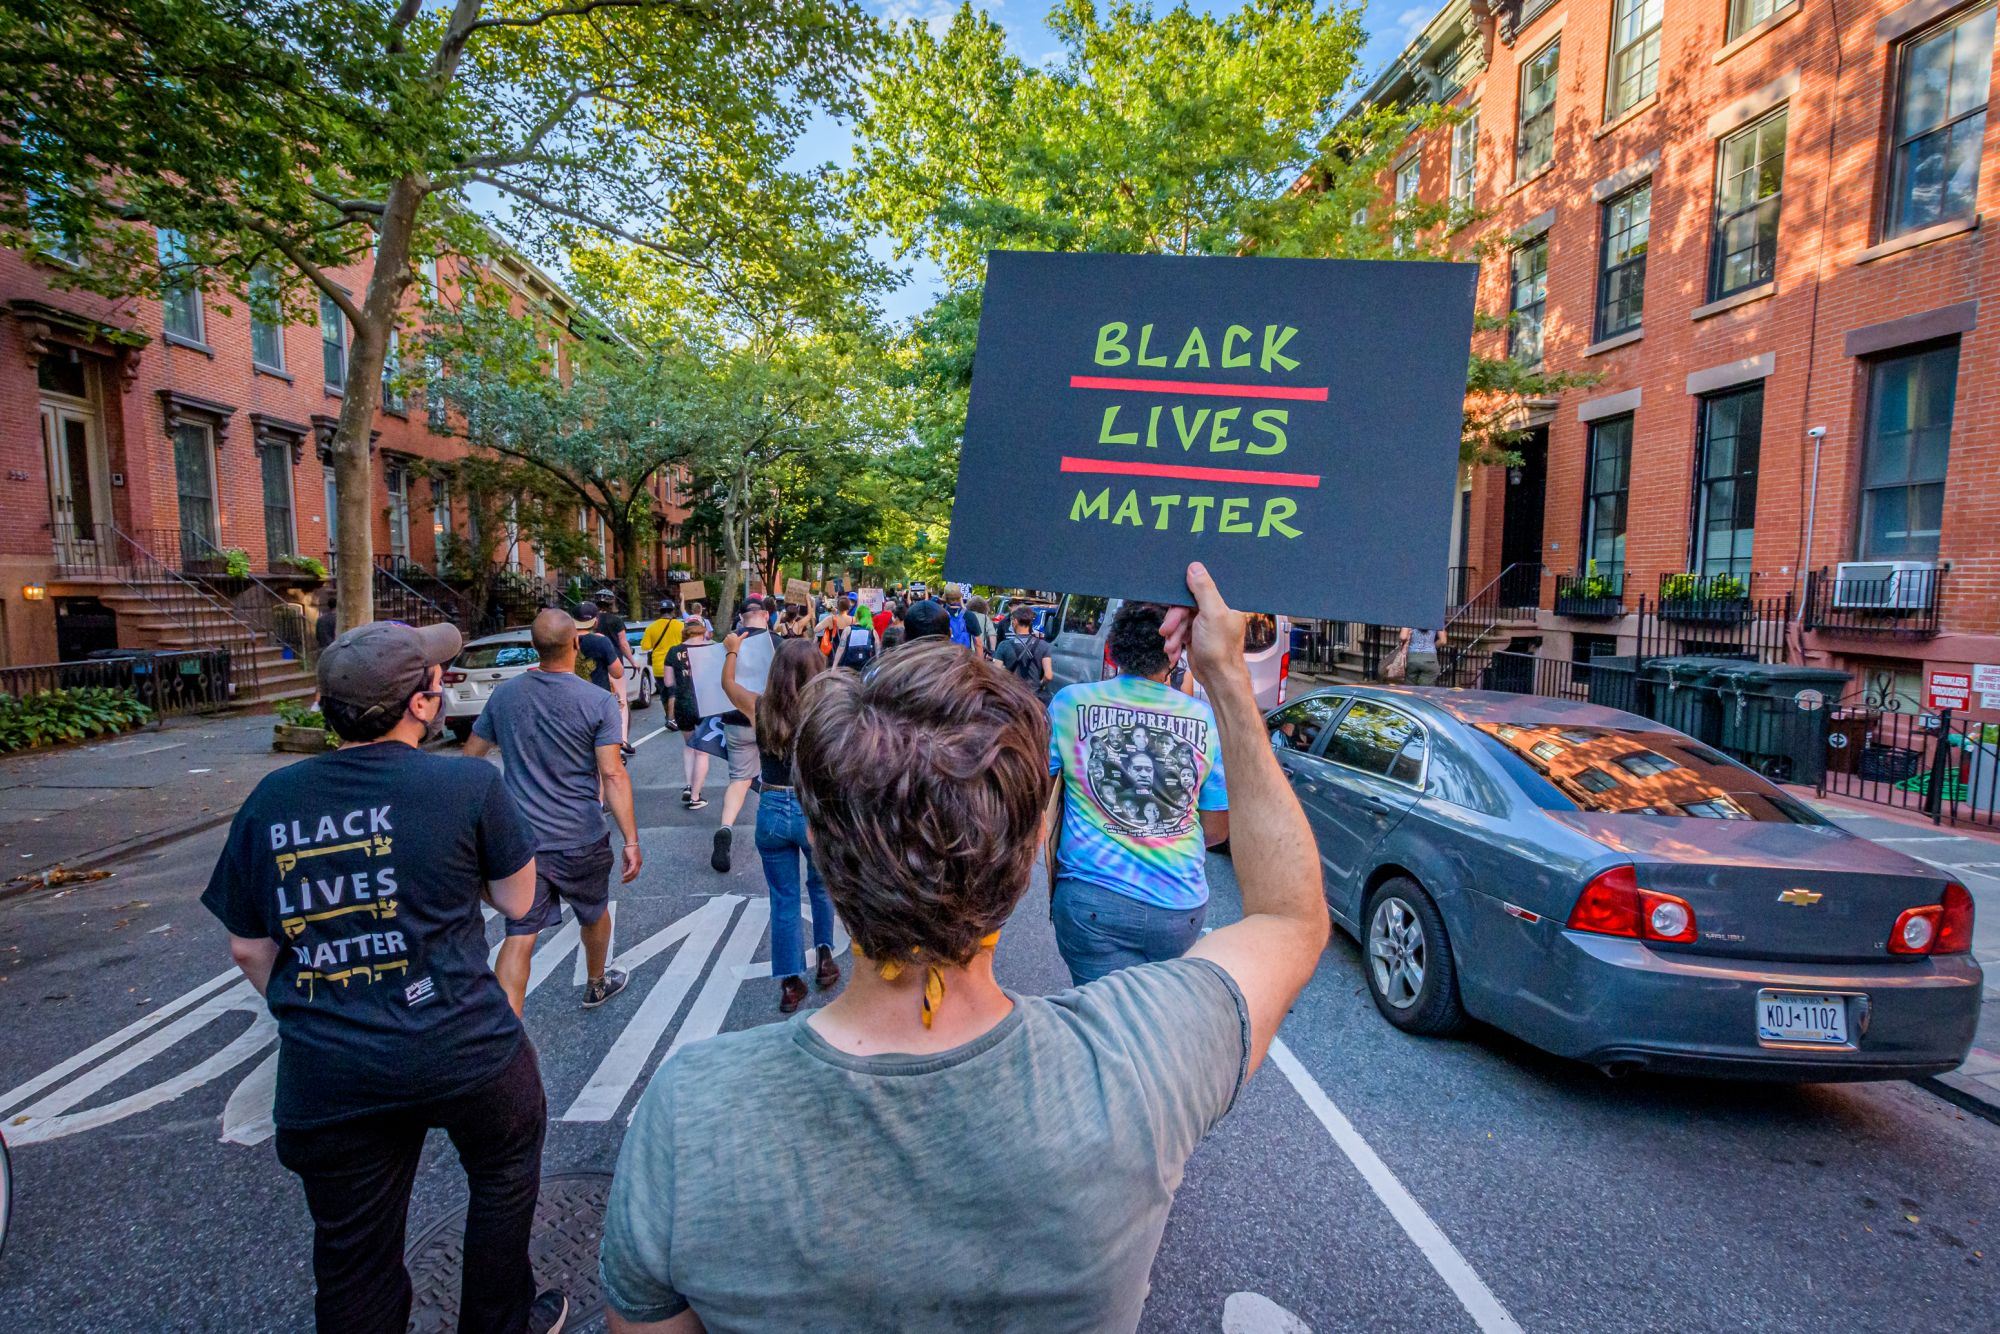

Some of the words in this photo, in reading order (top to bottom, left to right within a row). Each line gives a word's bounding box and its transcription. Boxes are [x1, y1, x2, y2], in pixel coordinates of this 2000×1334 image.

[1093, 321, 1301, 373] BLACK
[1098, 405, 1290, 456] LIVES
[1069, 487, 1304, 539] MATTER
[1077, 705, 1088, 741] I
[1135, 711, 1207, 753] BREATHE
[270, 805, 393, 850] BLACK
[276, 868, 398, 915] LIVES
[292, 931, 408, 968] MATTER
[1778, 996, 1799, 1004] NEW
[1800, 997, 1823, 1006] YORK
